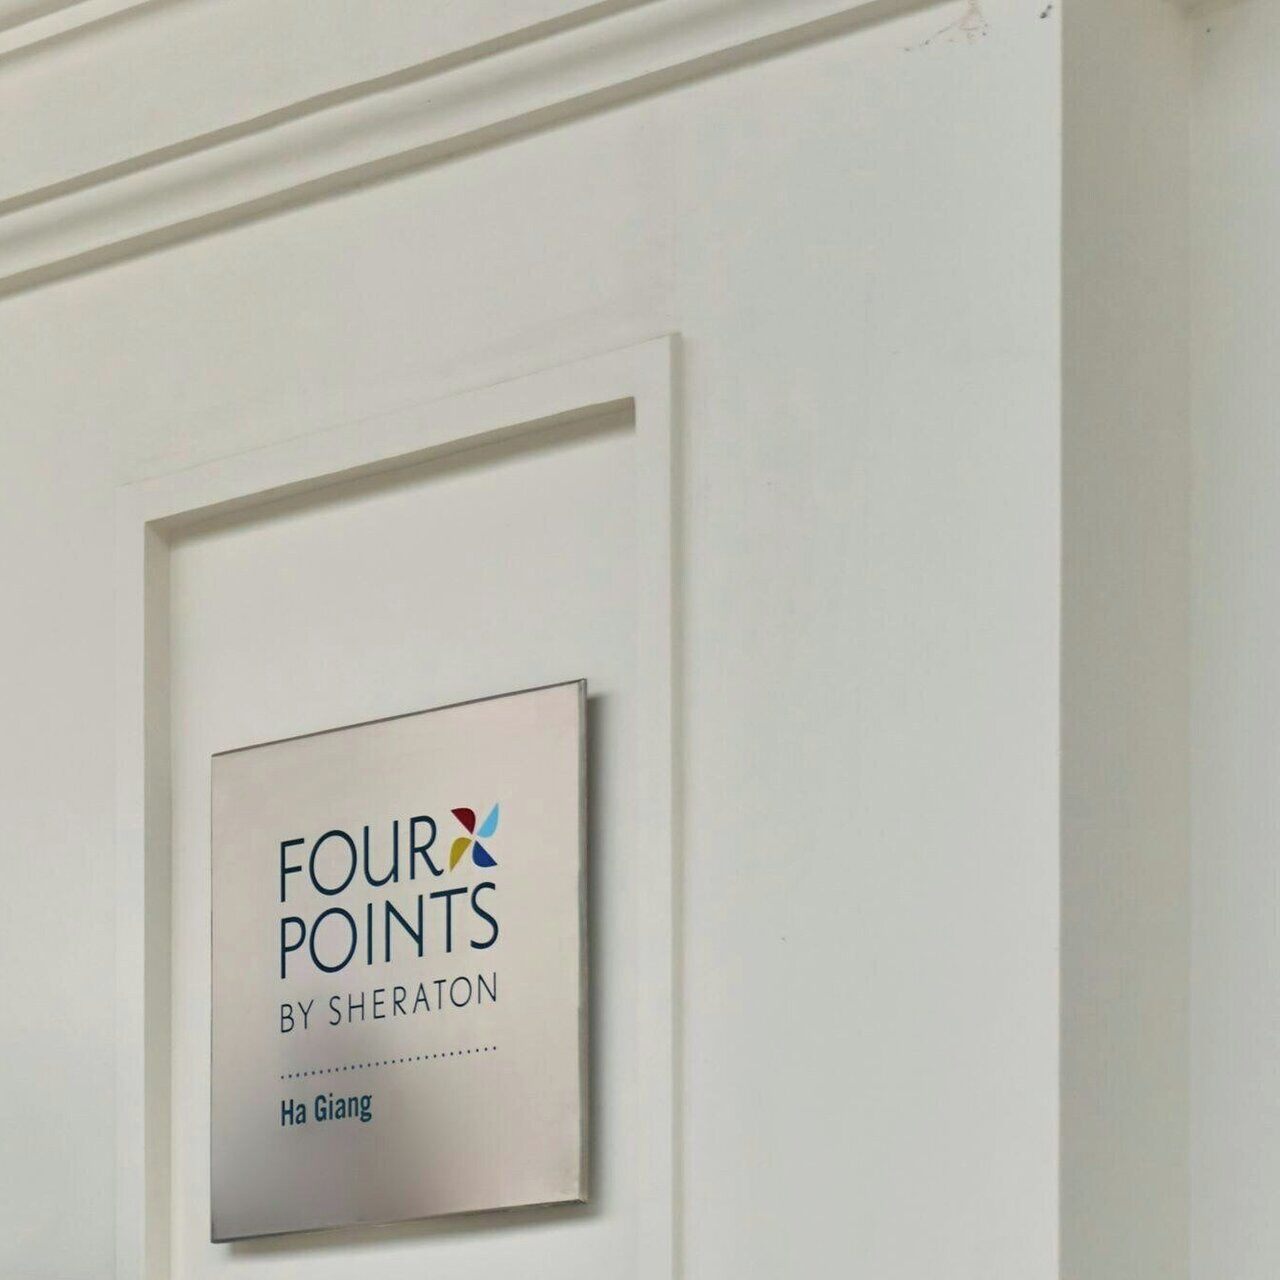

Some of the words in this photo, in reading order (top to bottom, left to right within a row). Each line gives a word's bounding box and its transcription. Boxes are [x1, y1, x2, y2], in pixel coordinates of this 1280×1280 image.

[279, 814, 446, 904] FOUR
[279, 880, 501, 981] POINTS
[280, 998, 316, 1035] BY
[328, 970, 499, 1028] SHERATON
[280, 1098, 308, 1128] Ha
[313, 1093, 374, 1124] Giang
